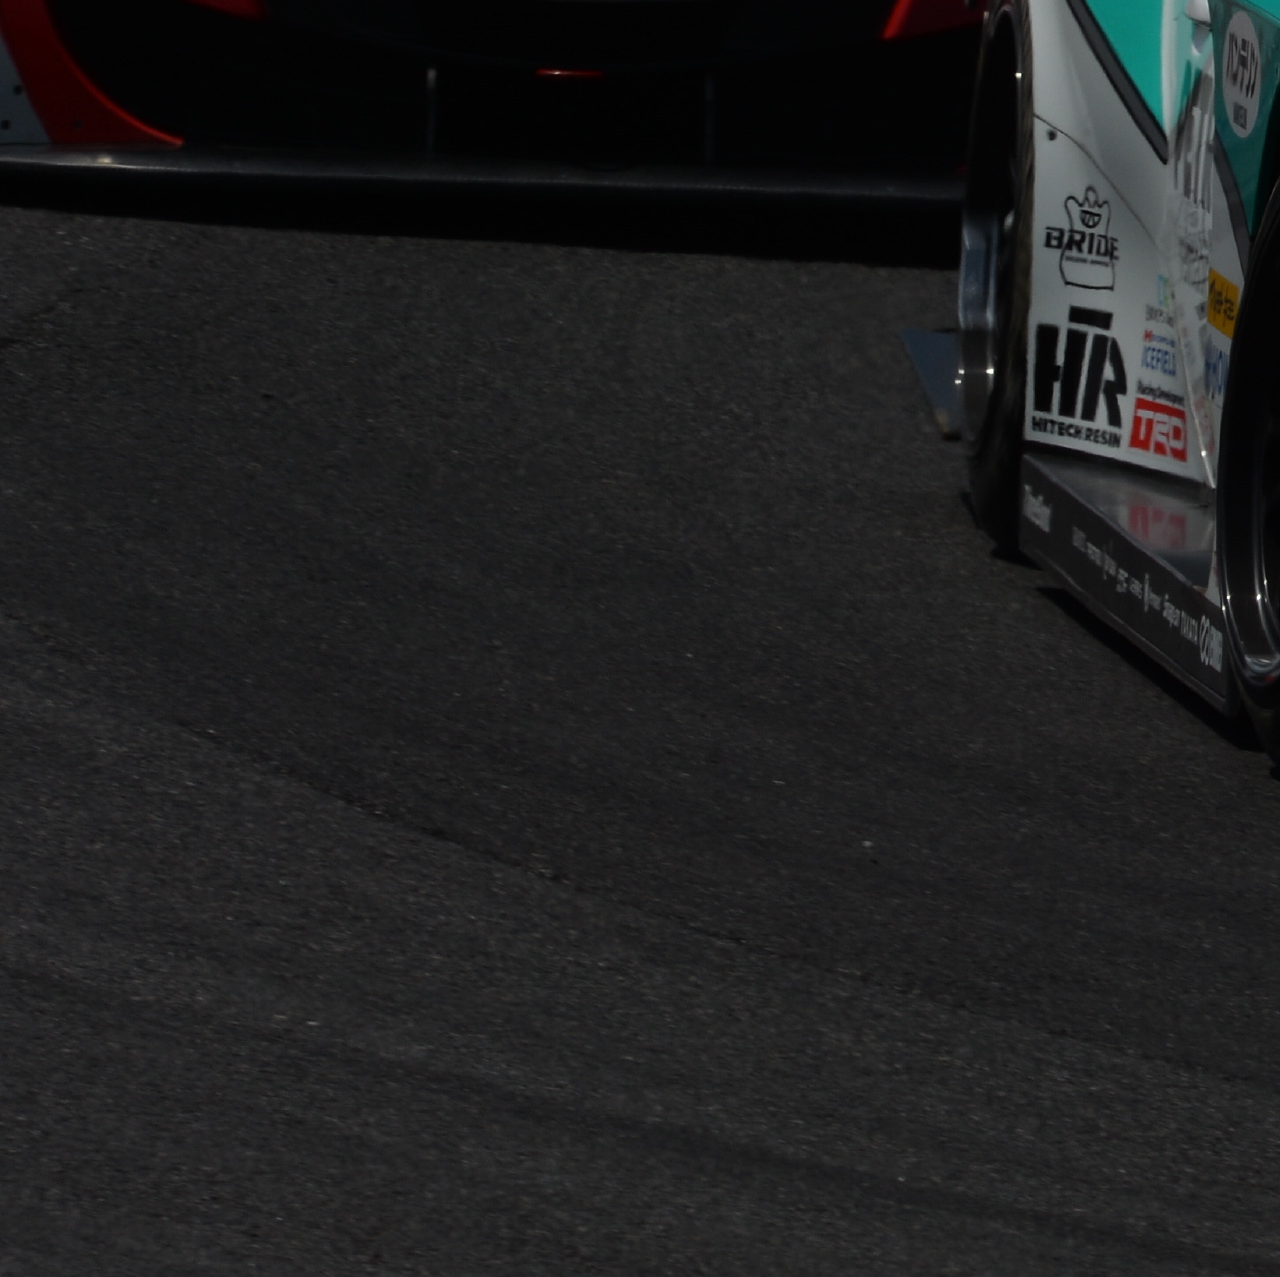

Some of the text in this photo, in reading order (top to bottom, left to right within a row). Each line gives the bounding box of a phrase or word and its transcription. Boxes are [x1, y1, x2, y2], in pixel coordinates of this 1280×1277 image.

[1044, 226, 1120, 262] BRIDE
[1031, 415, 1123, 449] HITECH RESIN
